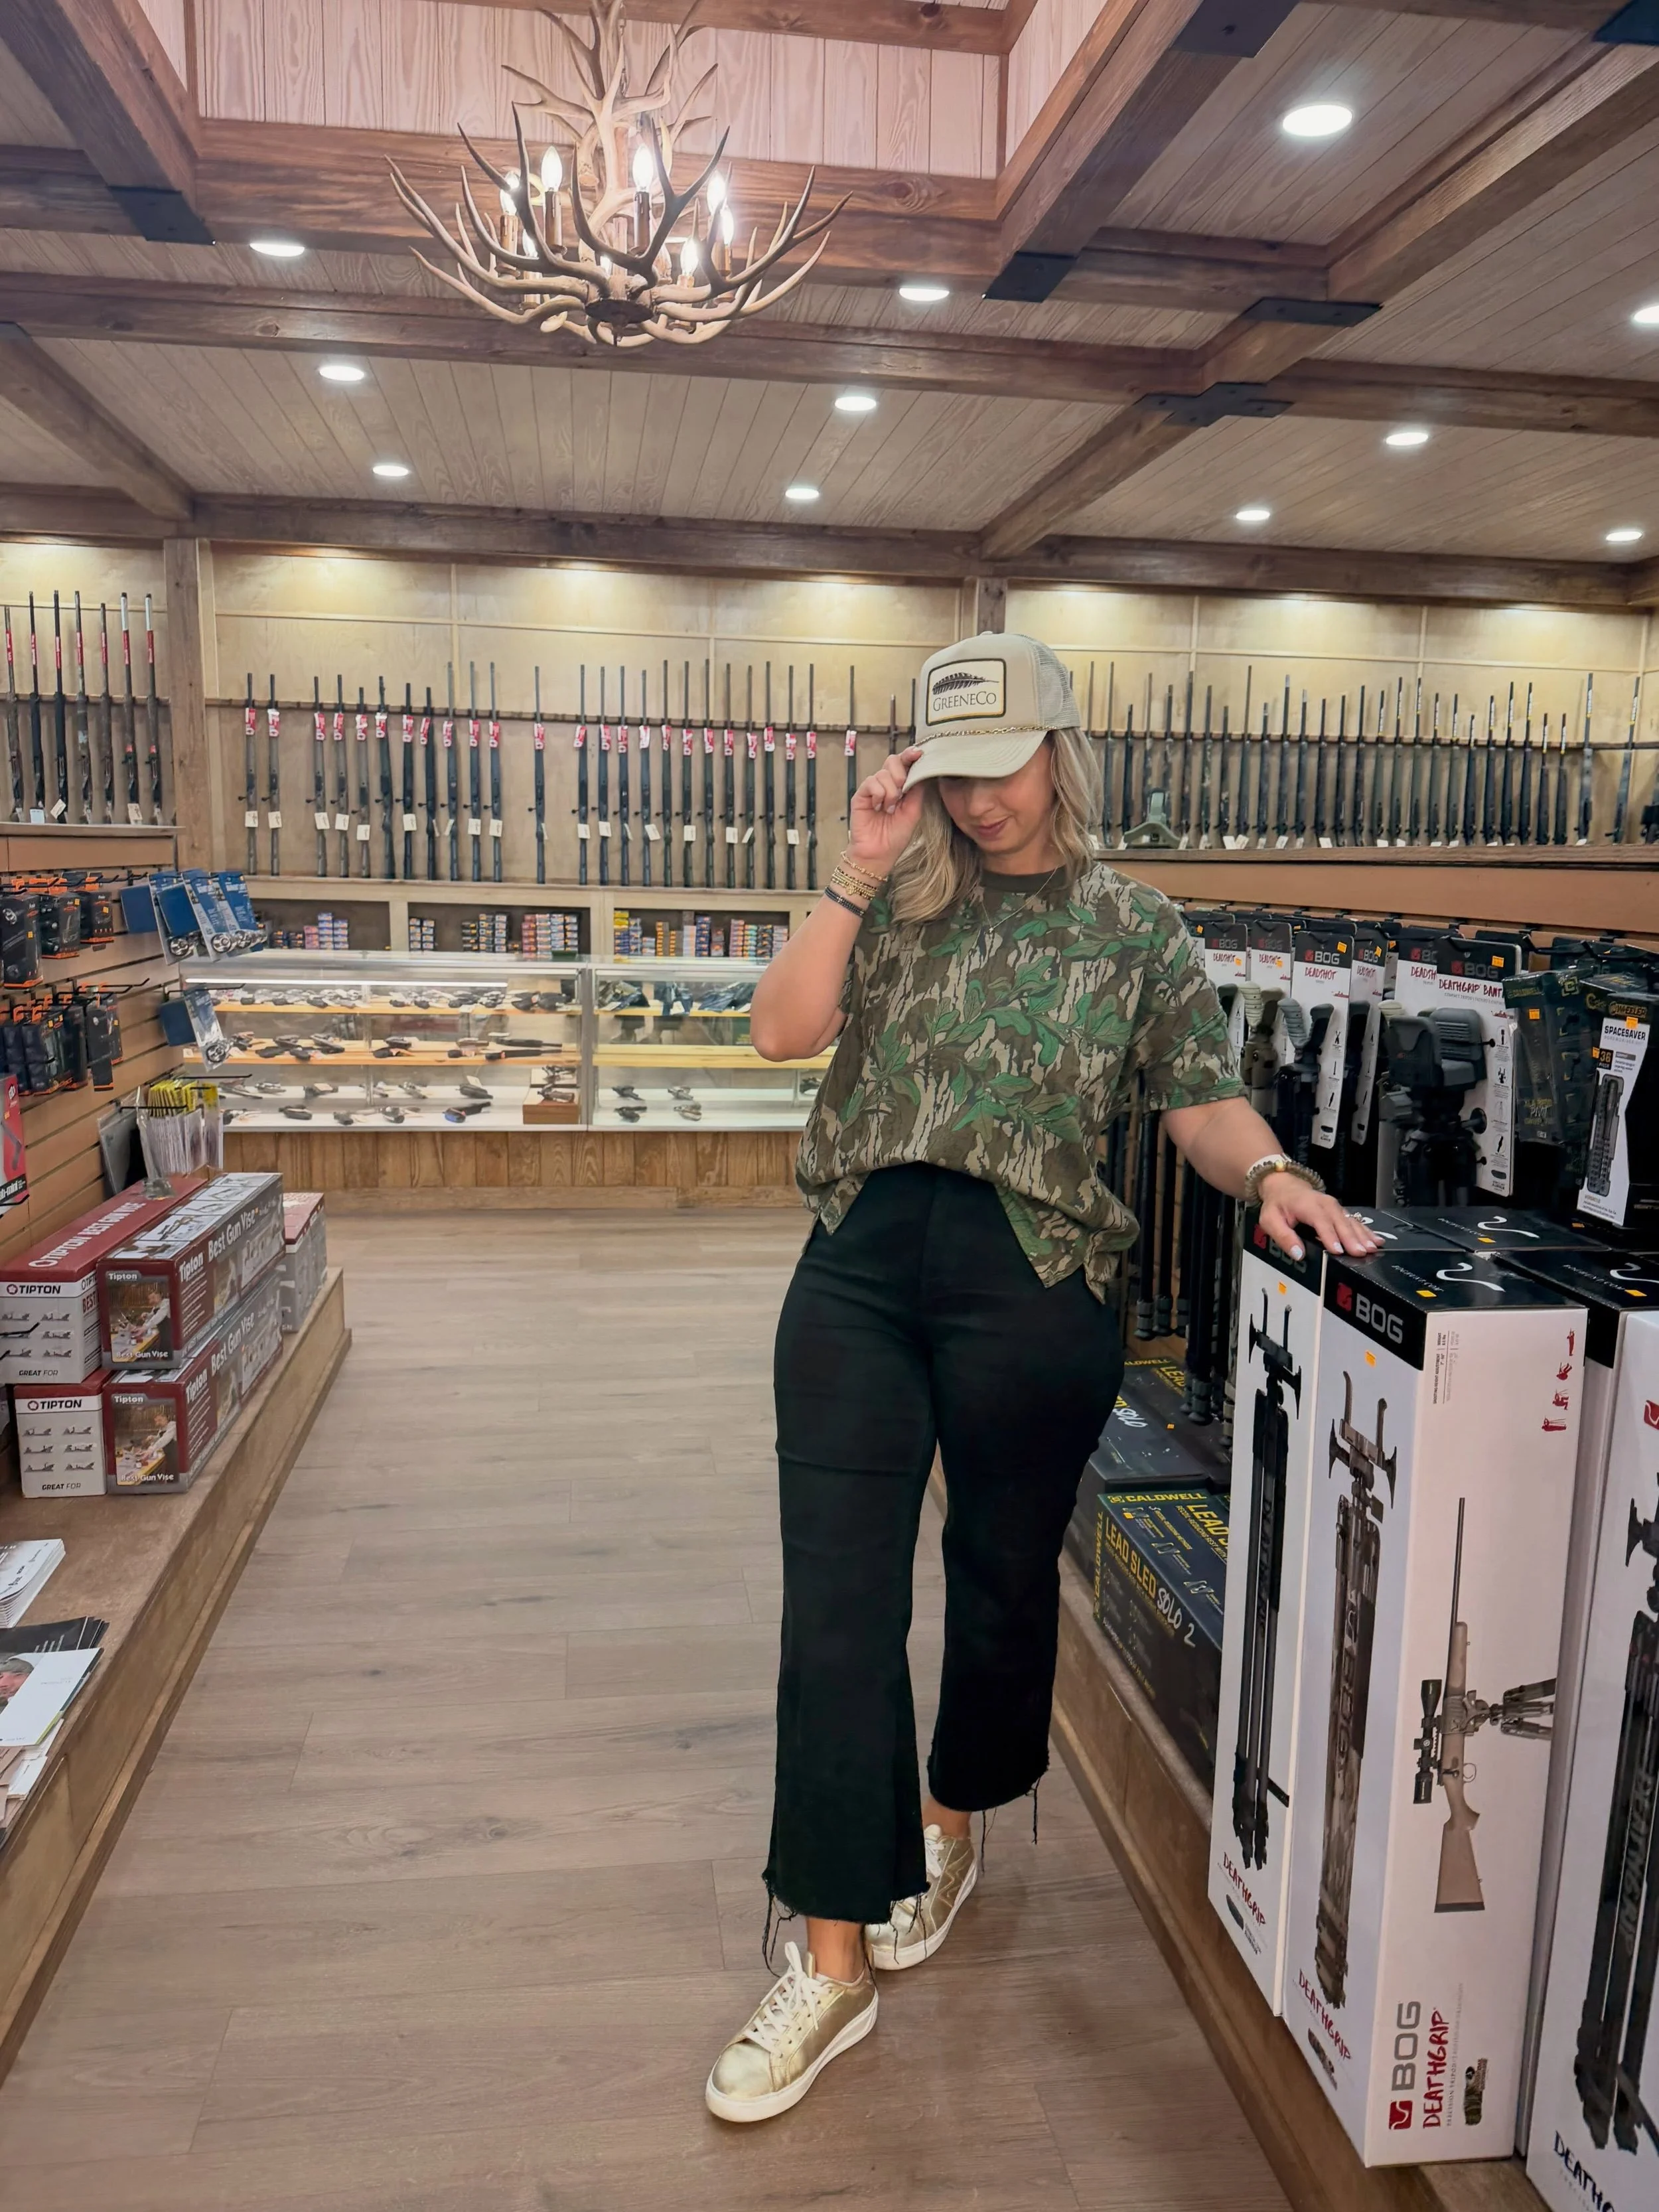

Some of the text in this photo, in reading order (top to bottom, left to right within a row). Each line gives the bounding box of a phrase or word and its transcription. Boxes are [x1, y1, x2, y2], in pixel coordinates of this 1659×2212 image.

[1219, 938, 1238, 949] BOG
[1315, 950, 1340, 964] BOG
[1363, 950, 1378, 963] BOG
[1305, 966, 1338, 980] DEADSHOT
[1411, 966, 1437, 982] DEADSH
[1464, 963, 1498, 979] BOG
[1439, 979, 1503, 997] DEATHGRIP BANT
[1604, 1025, 1646, 1041] SPACESAVER
[1600, 1051, 1611, 1063] 36
[208, 1209, 255, 1262] Best Gun Vise
[40, 1236, 92, 1260] TIPTON
[179, 1252, 204, 1282] Tipton
[19, 1285, 61, 1294] TIPTON
[82, 1291, 96, 1314] BEST
[1356, 1293, 1404, 1344] BOG
[212, 1312, 255, 1376] Best Gun Vise
[186, 1368, 208, 1404] Tipton
[40, 1400, 82, 1410] TIPTON
[1126, 1493, 1208, 1502] CALDWELL
[1187, 1504, 1229, 1536] LEAD
[1106, 1516, 1129, 1563] LEAD
[1130, 1550, 1157, 1599] SLED
[1157, 1587, 1183, 1629] SOLO
[1183, 1623, 1196, 1648] 2
[1223, 1852, 1266, 1926] DEATHGRIP
[1299, 1968, 1351, 2061] DEATHGRIP
[1392, 2001, 1421, 2091] BOG
[1423, 2010, 1449, 2129] DEATHGRIP
[1554, 2129, 1615, 2212] DEATH
